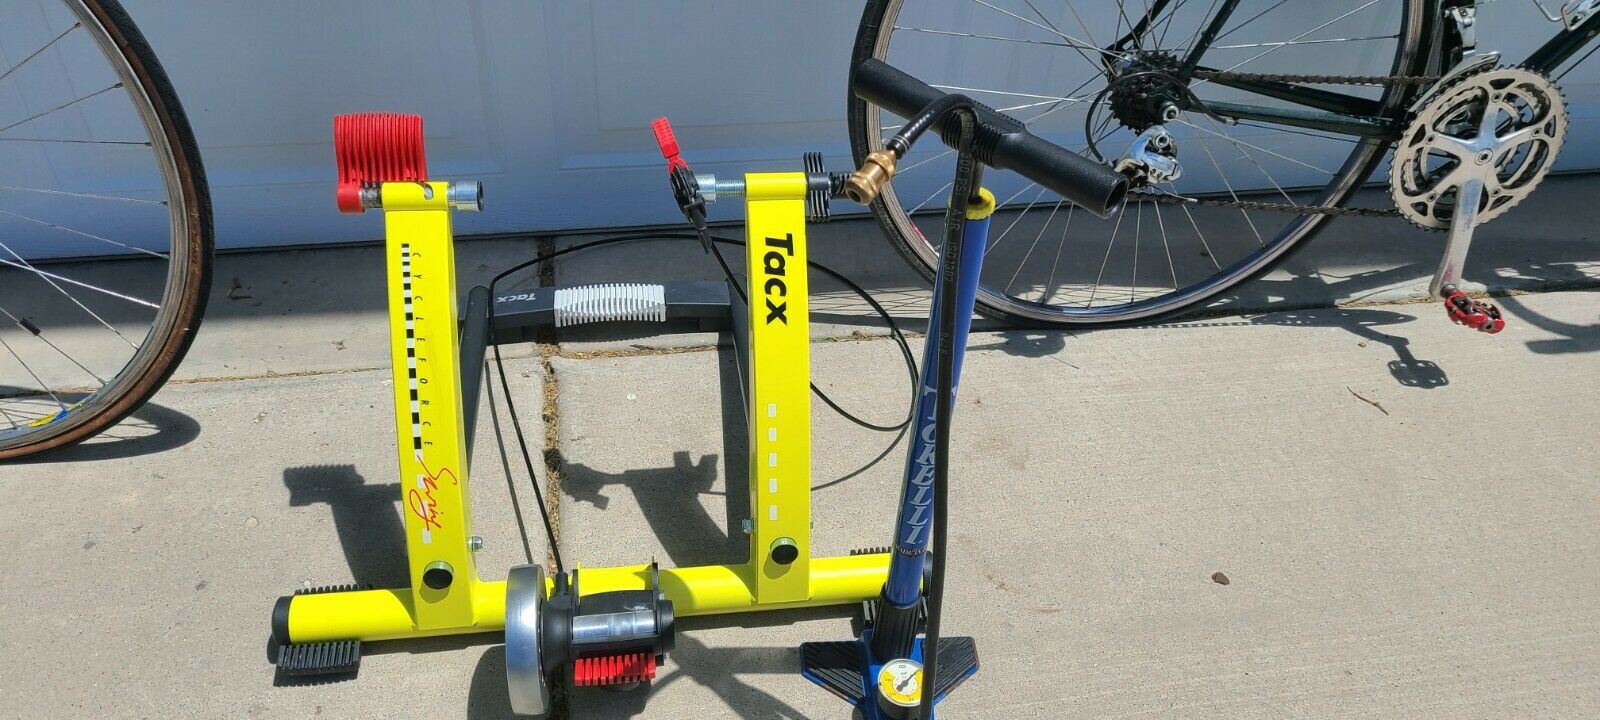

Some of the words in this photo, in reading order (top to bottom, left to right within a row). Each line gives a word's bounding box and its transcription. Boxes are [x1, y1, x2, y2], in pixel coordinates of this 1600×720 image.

[496, 293, 536, 303] Tacx
[763, 233, 794, 326] Tacx
[413, 252, 432, 446] CYCLEFORCE
